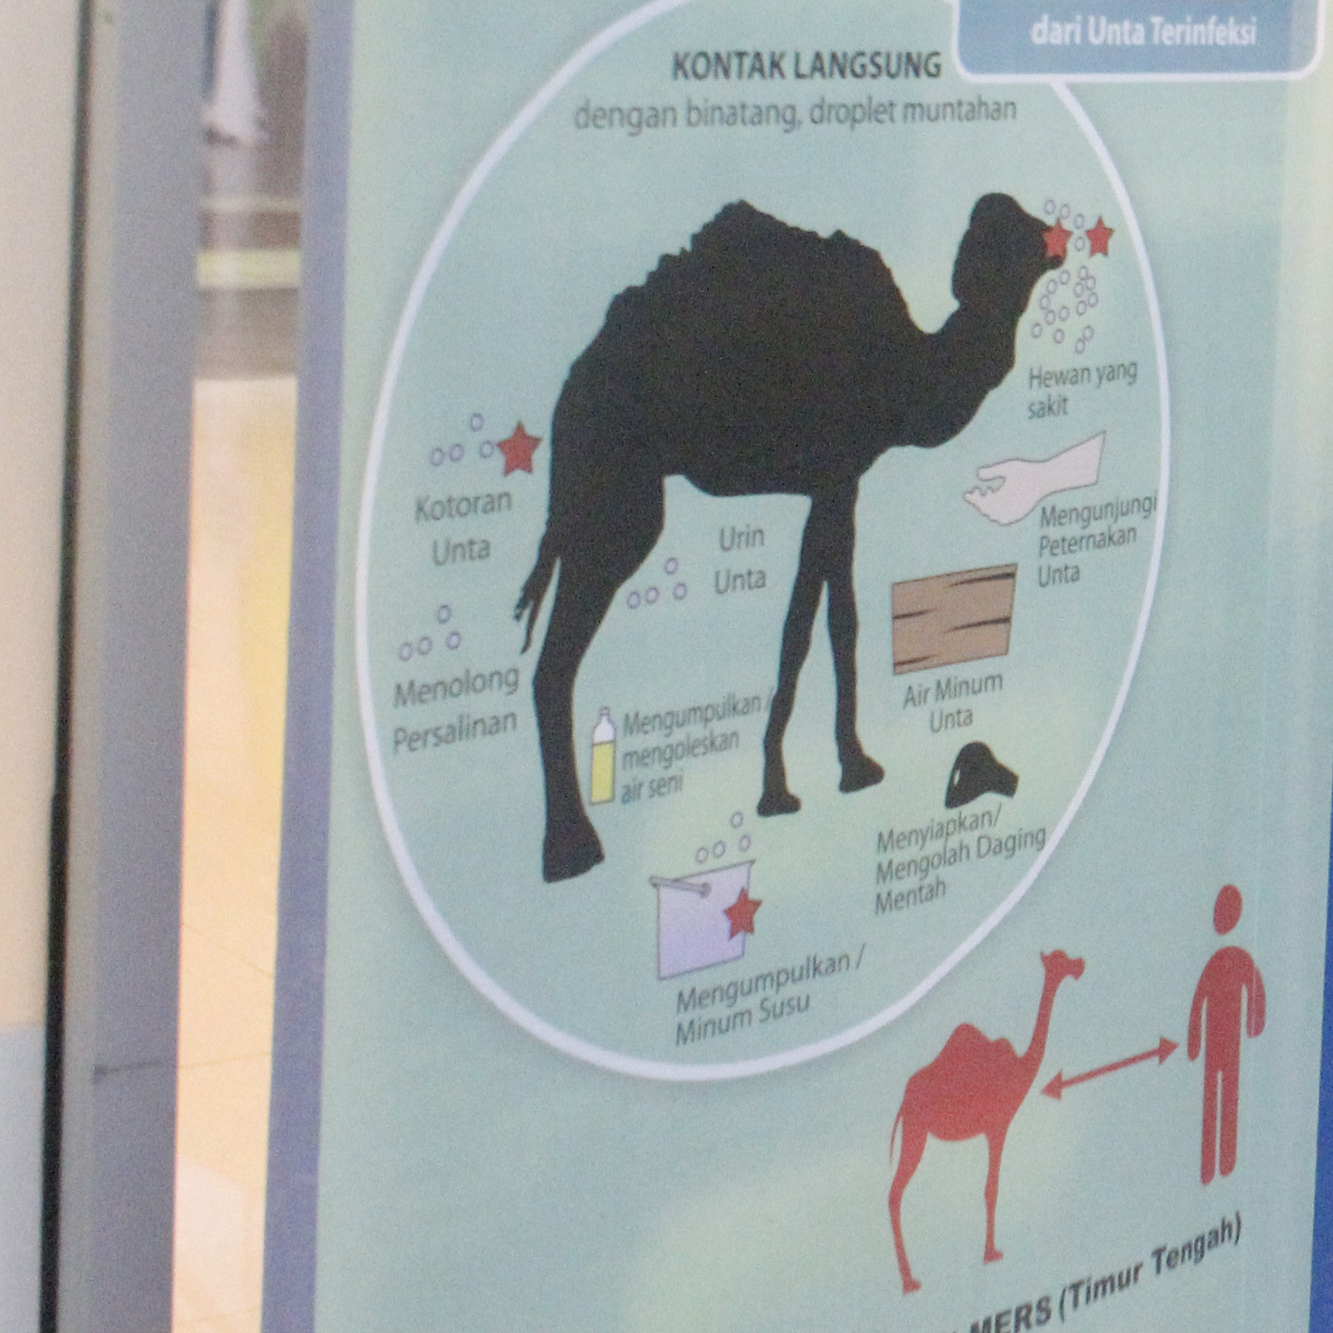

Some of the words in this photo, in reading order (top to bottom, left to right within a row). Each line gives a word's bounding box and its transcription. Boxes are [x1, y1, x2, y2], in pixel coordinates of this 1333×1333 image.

[1031, 15, 1081, 46] dari
[1088, 16, 1145, 46] Unta
[1151, 16, 1258, 46] Terinfeksi
[672, 50, 787, 81] KONTAK
[794, 50, 942, 80] LANGSUNG
[574, 100, 677, 136] dengan
[811, 95, 897, 131] droplet
[903, 94, 1017, 123] muntahan
[1029, 365, 1091, 390] Hewan
[1096, 361, 1138, 388] yang
[1028, 395, 1069, 420] sakit
[415, 490, 513, 523] Kotoran
[1040, 490, 1158, 530] Mengunjungi
[431, 537, 491, 566] Unta
[718, 523, 765, 553] Urin
[1038, 525, 1137, 558] Peternakan
[714, 567, 767, 595] Unta
[1038, 564, 1081, 588] Unta
[393, 666, 521, 709] Menolong
[903, 684, 931, 710] Air
[935, 672, 1003, 702] Minum
[393, 709, 517, 755] Persalinan
[622, 691, 762, 737] Mengumpulkan
[929, 707, 973, 734] Unta
[622, 727, 740, 770] mengoleskan
[621, 777, 643, 805] air
[648, 772, 684, 799] seni
[876, 803, 1002, 855] Menyiapkan/
[875, 840, 970, 885] Mengolah
[976, 826, 1047, 860] Daging
[875, 875, 946, 916] Mentah
[676, 952, 850, 1015] Mengumpulkan
[675, 1007, 752, 1047] Minum
[759, 994, 810, 1023] Susu
[1059, 1262, 1143, 1323] (Timur
[1151, 1211, 1242, 1277] Tengah)
